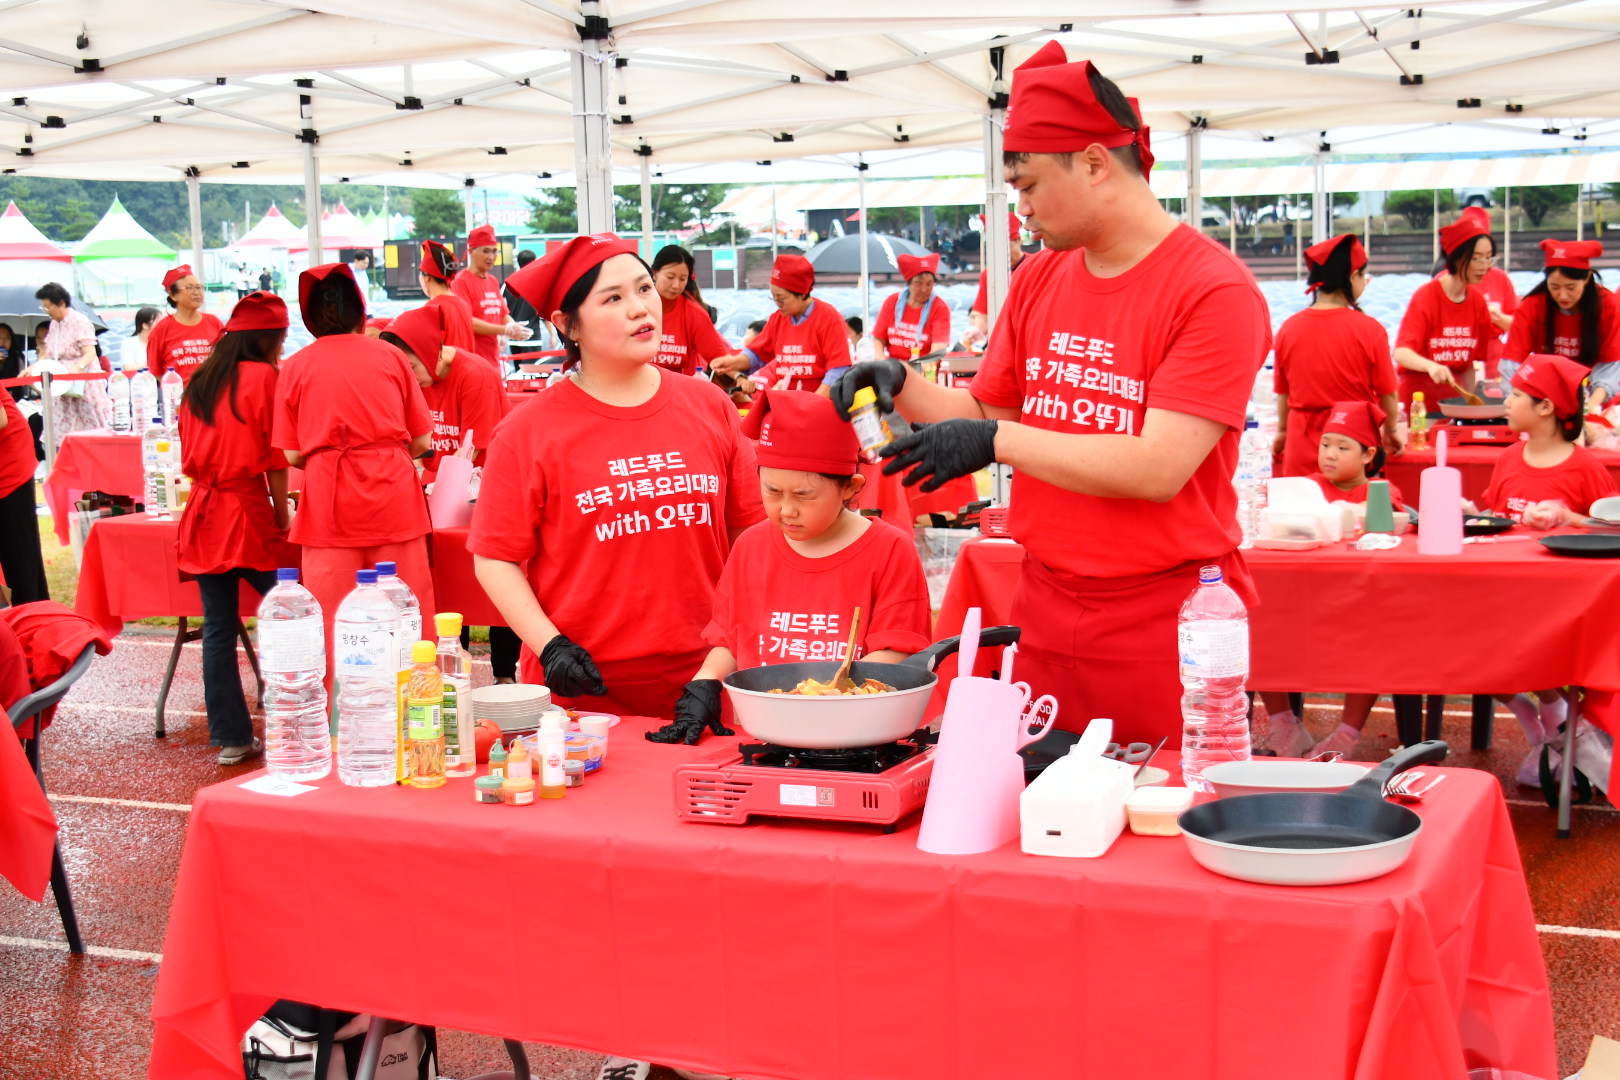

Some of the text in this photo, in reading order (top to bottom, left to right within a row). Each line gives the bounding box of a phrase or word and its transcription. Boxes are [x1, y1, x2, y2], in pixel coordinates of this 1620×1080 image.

[182, 339, 210, 347] 레드푸드
[1442, 327, 1471, 337] 레드푸드
[1048, 331, 1115, 365] 레드푸드
[1433, 350, 1453, 362] with
[176, 356, 197, 366] with
[1045, 361, 1145, 404] 가족요리대회
[1072, 398, 1134, 435] 오뚜기
[607, 451, 686, 476] 레드푸드
[575, 473, 719, 514] 전국 가족요리대회
[595, 502, 712, 542] with 오뚜기
[770, 611, 840, 635] 레드푸드
[342, 633, 370, 646] 평창수
